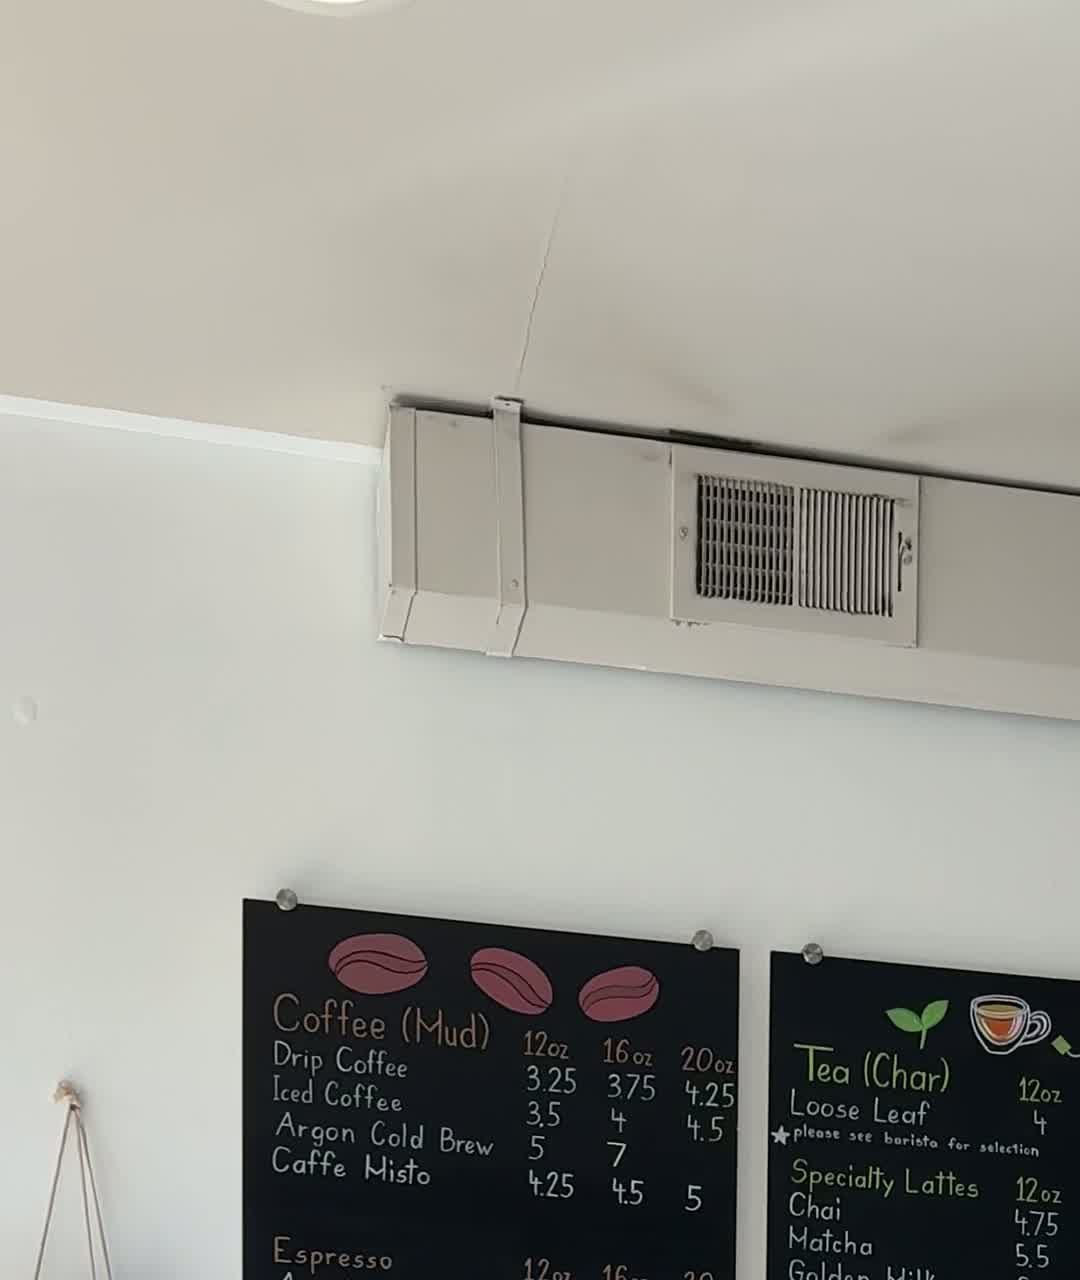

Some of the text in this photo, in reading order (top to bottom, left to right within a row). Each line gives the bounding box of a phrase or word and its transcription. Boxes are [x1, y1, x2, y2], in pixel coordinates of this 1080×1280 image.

[274, 993, 385, 1039] Coffee
[403, 1007, 489, 1049] (Mud)
[274, 1040, 734, 1108] Drip Coffee 3.25 3.75 4.25
[793, 1043, 849, 1084] Tea
[864, 1051, 949, 1092] (Char)
[791, 1088, 859, 1120] Loose
[874, 1097, 930, 1125] Leaf
[1034, 1110, 1047, 1135] 4
[275, 1112, 627, 1167] Argon Cold Brew 5 7
[272, 1146, 702, 1211] Caffe Misto 4.25 4.5 5
[791, 1158, 894, 1198] Specialty
[906, 1168, 978, 1197] Lattes
[789, 1192, 840, 1221] Chai
[1015, 1208, 1059, 1236] 4.75
[274, 1236, 392, 1274] Espresso
[789, 1225, 872, 1255] Matcha
[1016, 1243, 1049, 1268] 5.5
